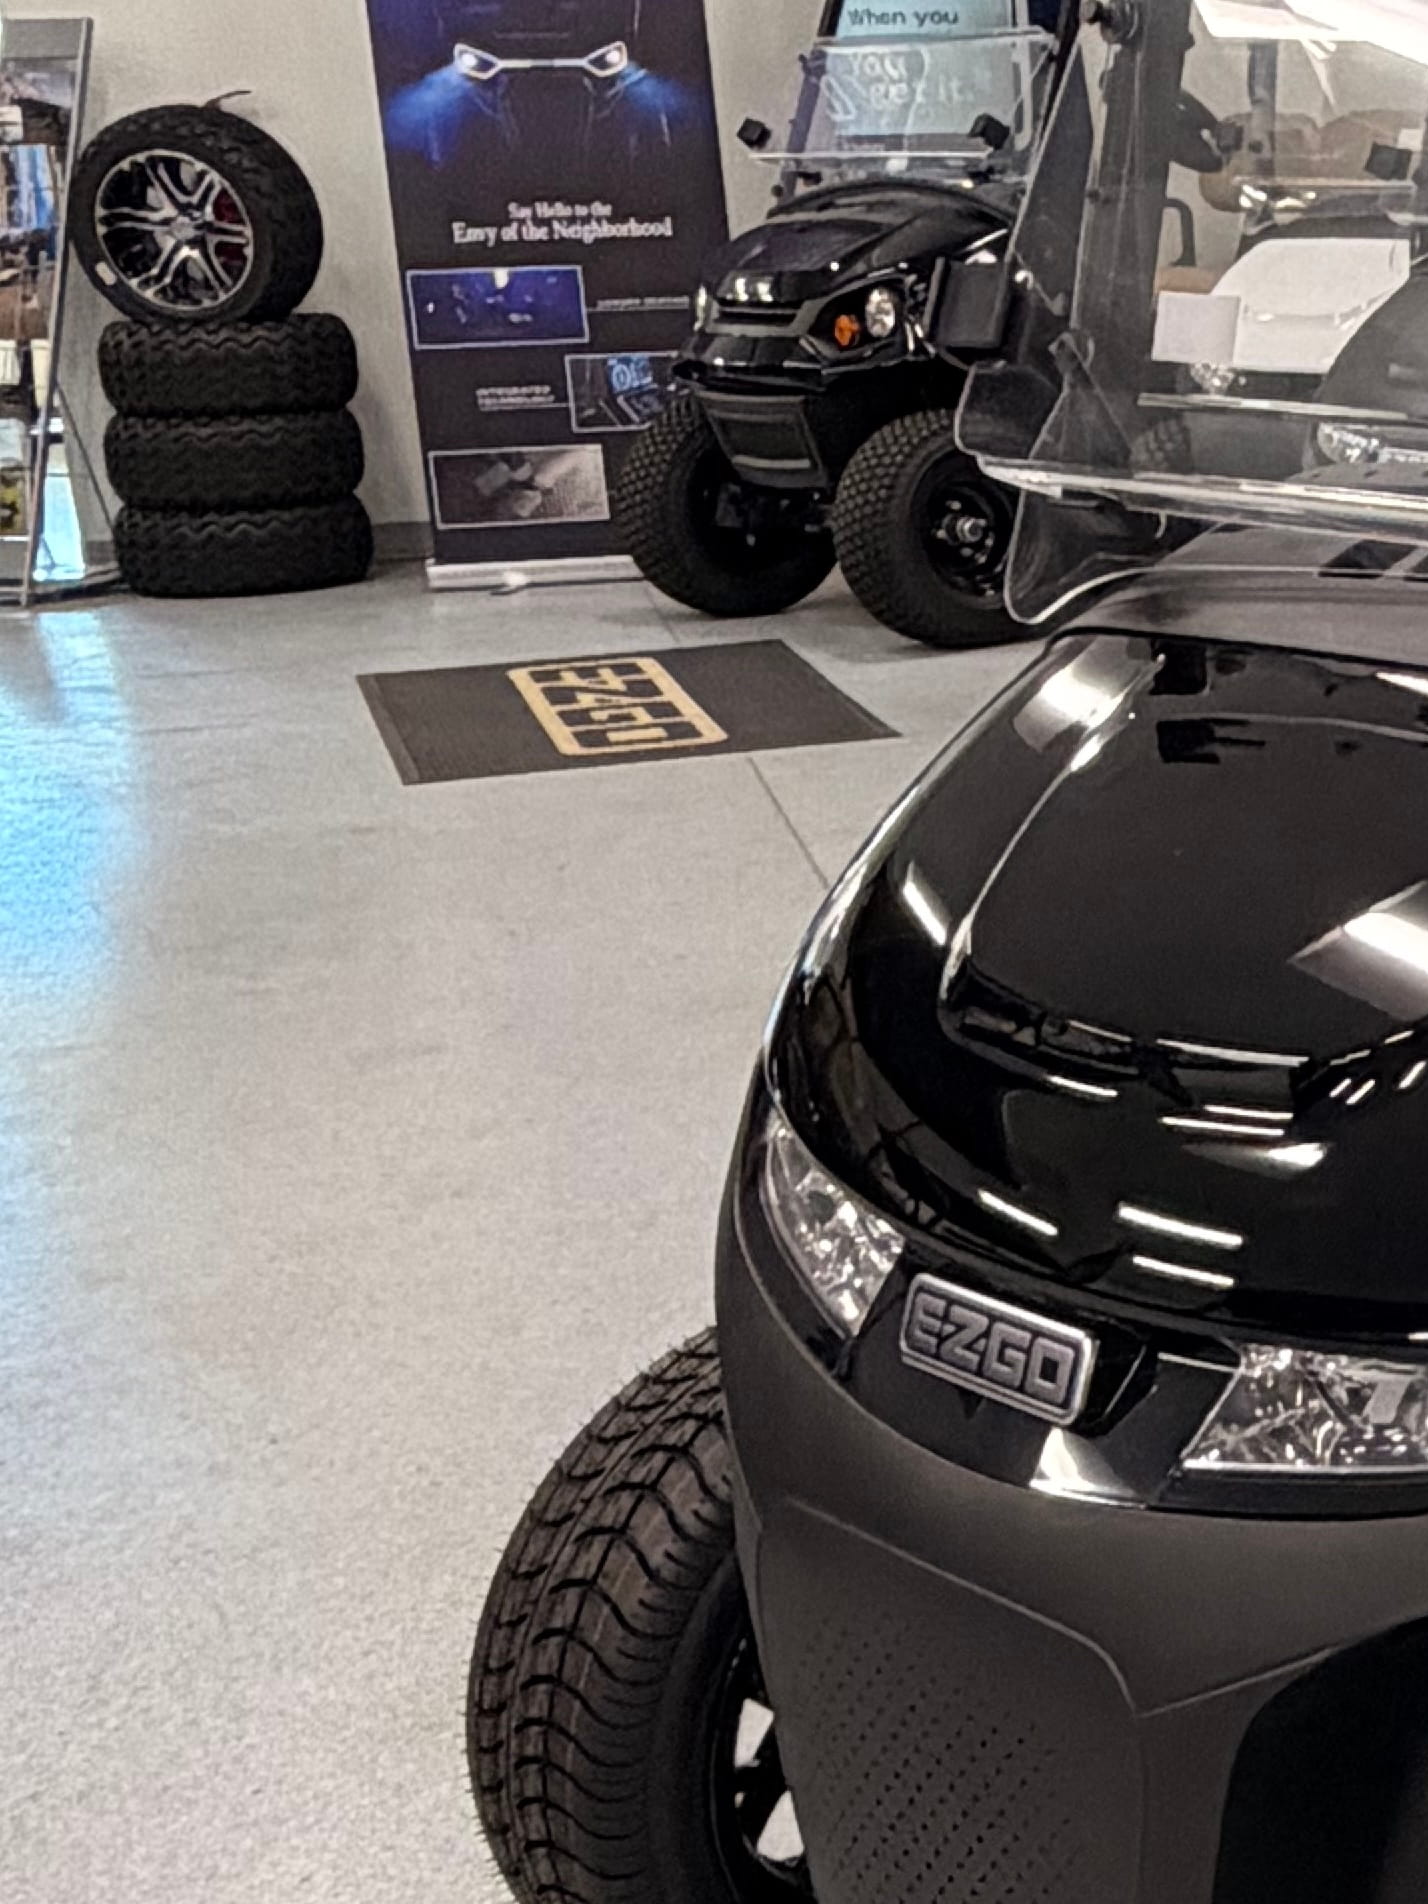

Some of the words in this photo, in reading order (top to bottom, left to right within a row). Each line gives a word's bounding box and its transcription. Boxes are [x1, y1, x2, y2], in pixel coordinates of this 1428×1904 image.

[848, 8, 906, 26] When
[913, 9, 959, 27] you
[452, 222, 497, 248] Envy
[501, 222, 518, 241] of
[522, 218, 549, 241] the
[552, 215, 673, 244] Neighborhood
